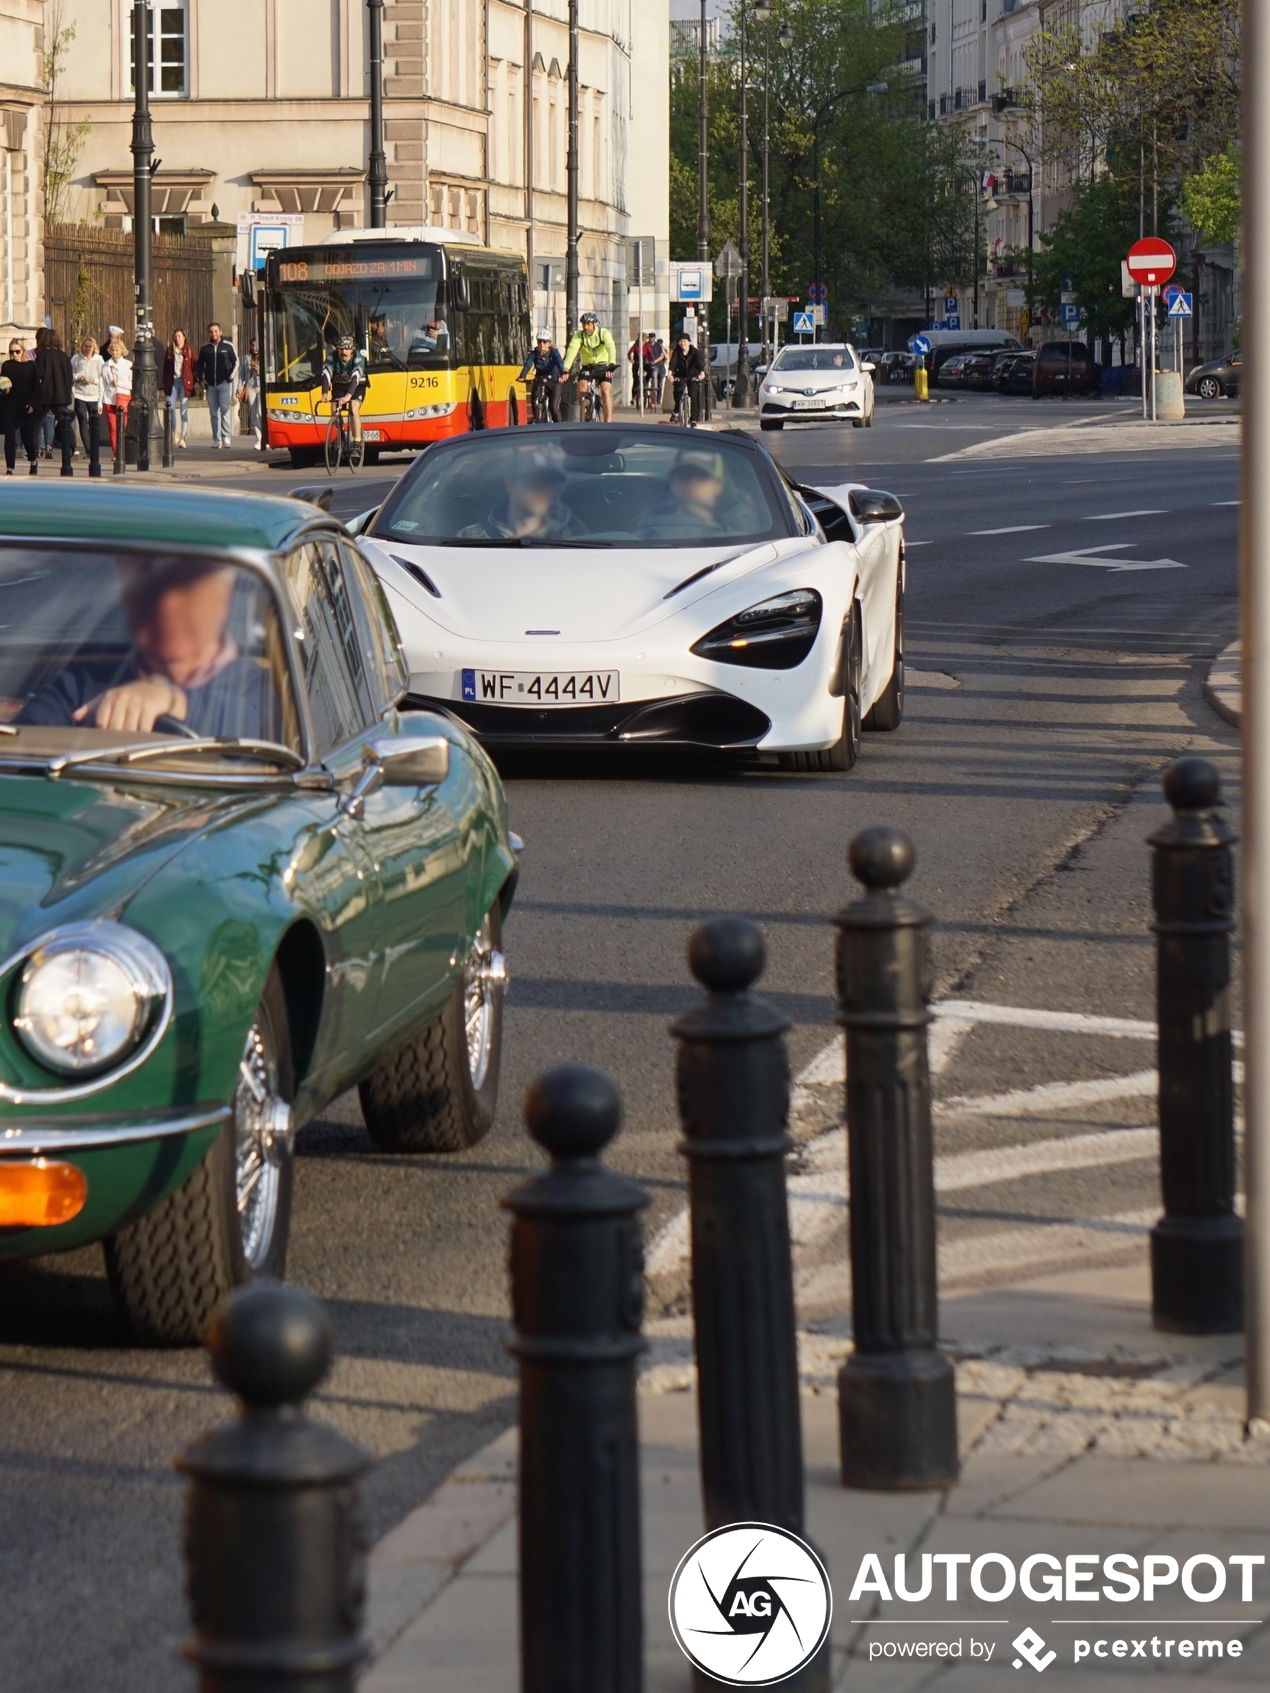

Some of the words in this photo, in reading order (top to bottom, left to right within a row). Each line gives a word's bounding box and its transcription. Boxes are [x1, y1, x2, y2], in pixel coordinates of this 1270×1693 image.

[279, 262, 309, 281] 108
[325, 263, 368, 275] ODJAZD
[410, 377, 439, 389] 9216
[465, 687, 475, 695] PL
[481, 673, 515, 699] WF
[527, 674, 612, 700] 4444V
